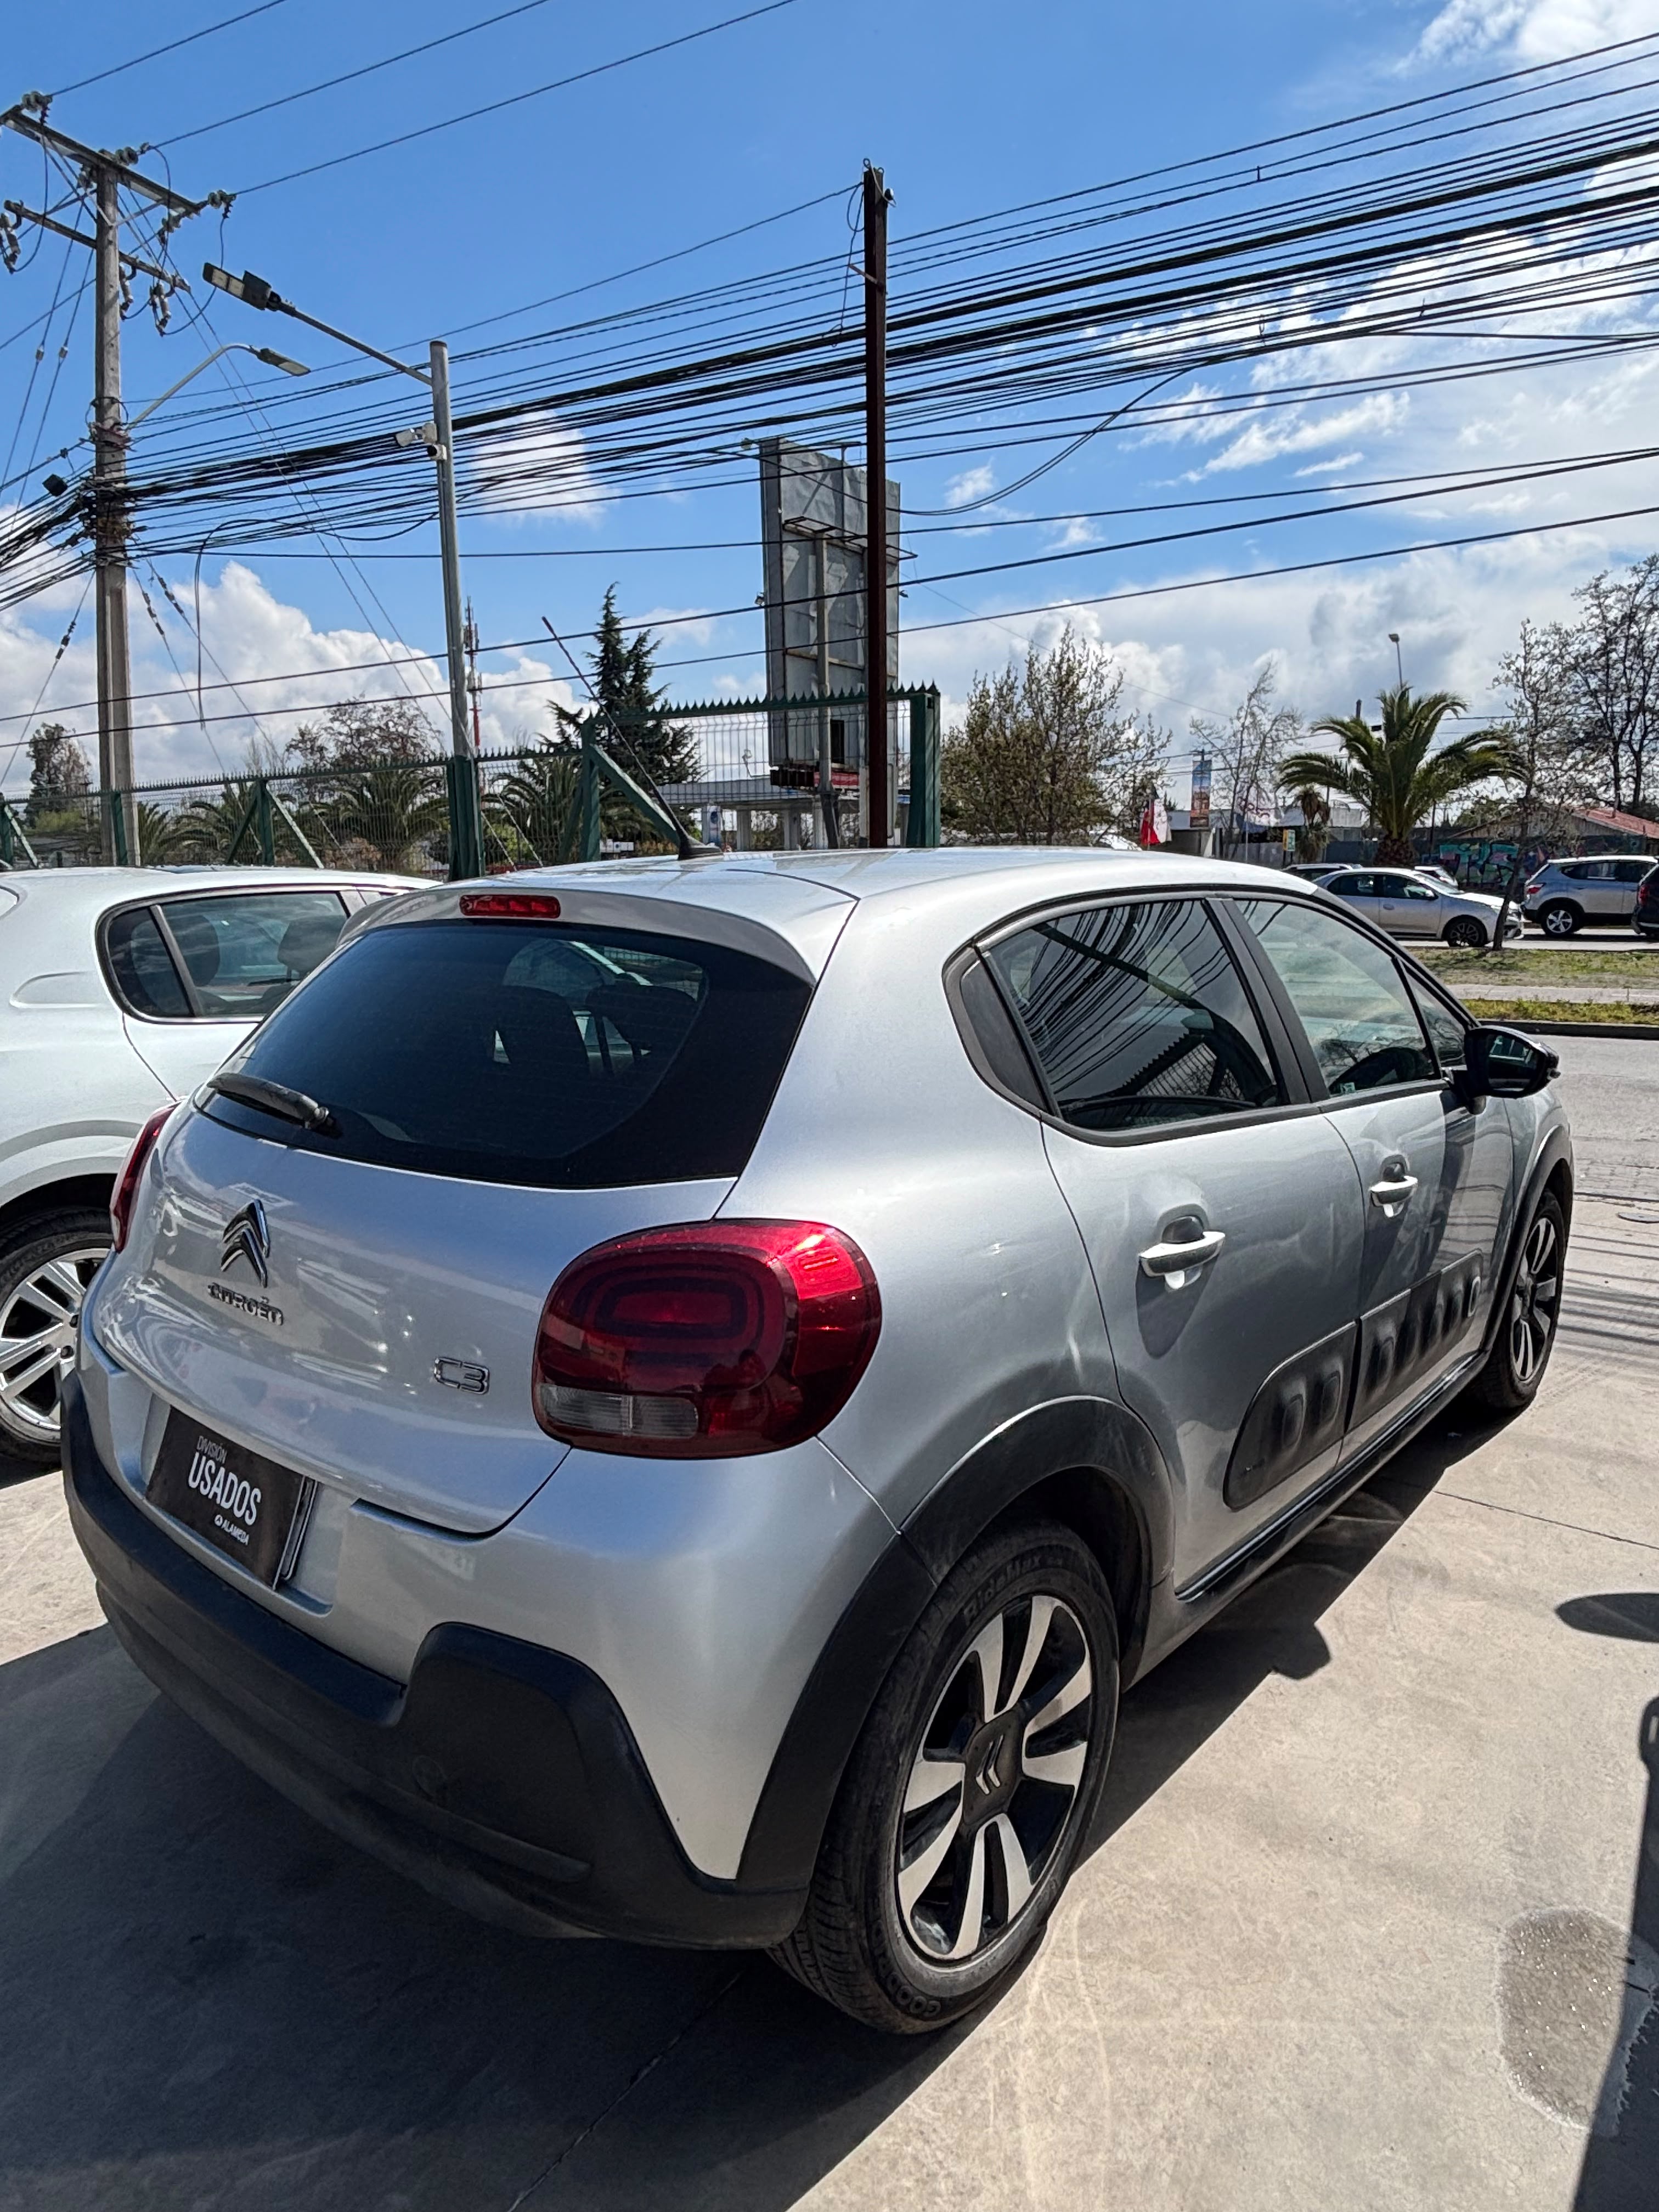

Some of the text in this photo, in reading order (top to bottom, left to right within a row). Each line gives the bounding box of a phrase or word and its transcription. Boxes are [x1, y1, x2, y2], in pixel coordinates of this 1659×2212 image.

[208, 1282, 284, 1326] CITROËN
[433, 1356, 490, 1395] C3
[188, 1451, 262, 1526] USADOS
